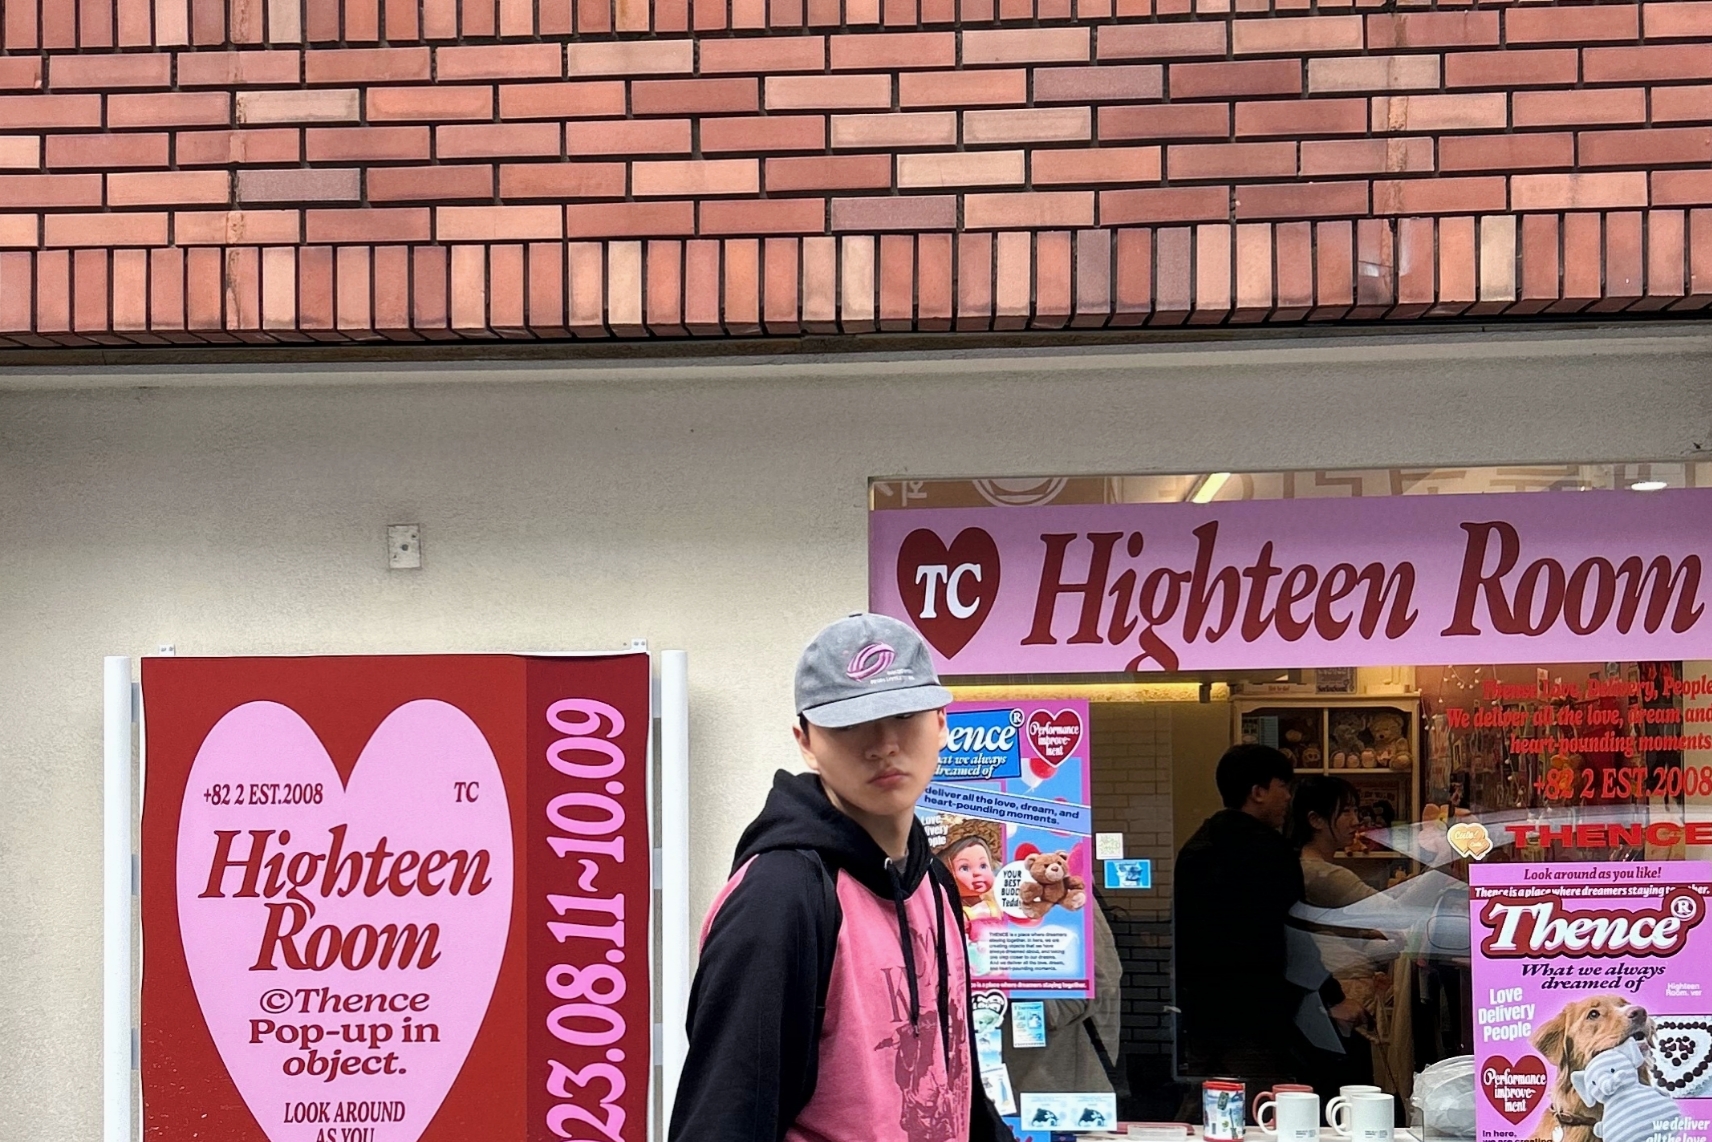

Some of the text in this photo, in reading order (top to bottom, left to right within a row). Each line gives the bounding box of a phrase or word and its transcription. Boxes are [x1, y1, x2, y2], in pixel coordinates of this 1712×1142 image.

[915, 520, 1704, 672] TC Highteen Room
[1446, 702, 1712, 729] We deliver all the love, dream and
[1510, 731, 1636, 758] heart-pounding
[454, 782, 479, 803] TC
[1534, 766, 1712, 799] +82 2 EST.2008
[203, 783, 323, 807] +82 2 EST.2008
[925, 787, 1080, 819] deliver all the love, dream, and
[924, 795, 1060, 825] heart-pounding moments.
[1505, 822, 1712, 847] THENCE
[198, 824, 492, 918] Highteen
[1003, 870, 1022, 878] YOUR
[1524, 867, 1662, 882] Look around as you like!
[1004, 879, 1021, 887] BEST
[1509, 887, 1517, 896] is
[1552, 887, 1581, 896] where
[1582, 886, 1627, 896] dreamers
[1628, 885, 1665, 896] staying
[249, 902, 441, 972] Room
[1521, 963, 1665, 979] What we always
[1541, 975, 1645, 992] dreamed of
[1489, 987, 1523, 1005] Love
[1478, 1004, 1535, 1025] Delivery
[249, 1016, 440, 1049] Pop-up in
[1483, 1022, 1532, 1043] People
[282, 1049, 407, 1083] object.
[1484, 1067, 1546, 1085] Performance
[284, 1101, 406, 1124] LOOK AROUND
[1505, 1100, 1526, 1112] ment
[1652, 1117, 1710, 1130] we deliver
